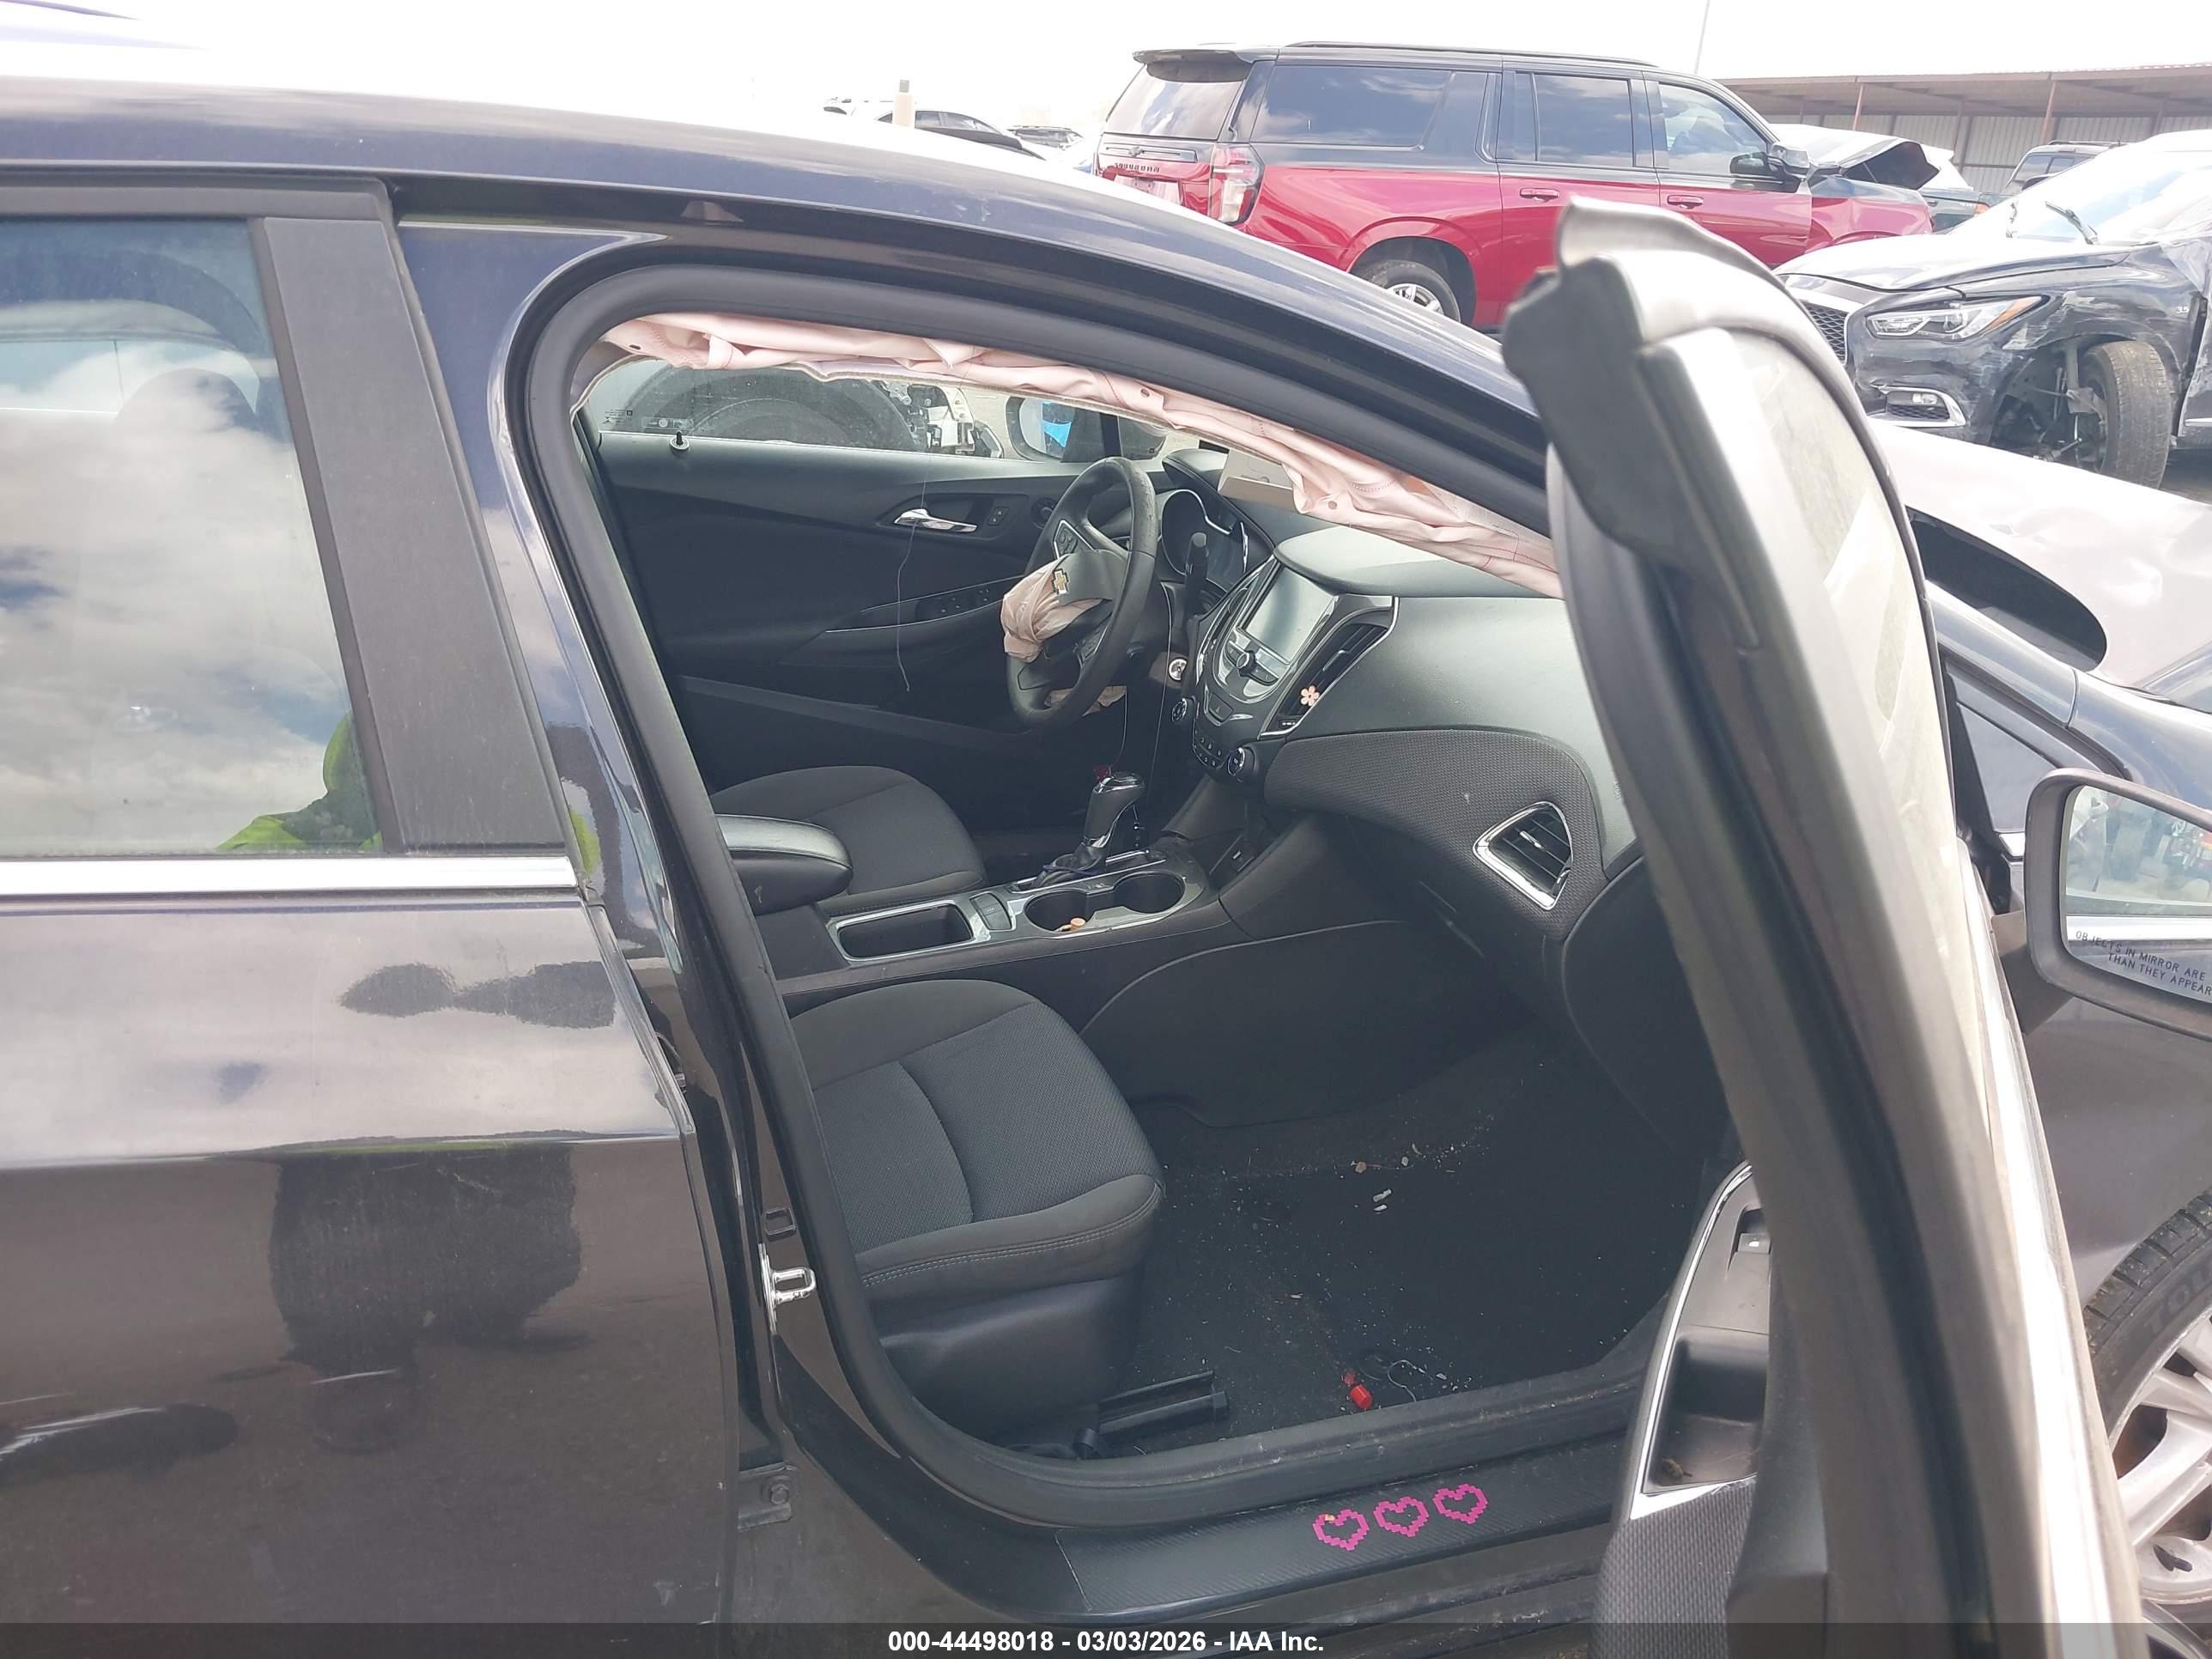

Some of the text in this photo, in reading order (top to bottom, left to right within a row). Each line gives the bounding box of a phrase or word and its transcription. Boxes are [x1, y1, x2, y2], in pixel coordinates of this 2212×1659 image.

[2075, 930, 2206, 981] OBJECTS IN MIRROR ARE
[2108, 952, 2212, 996] THAN THEY APPEAR
